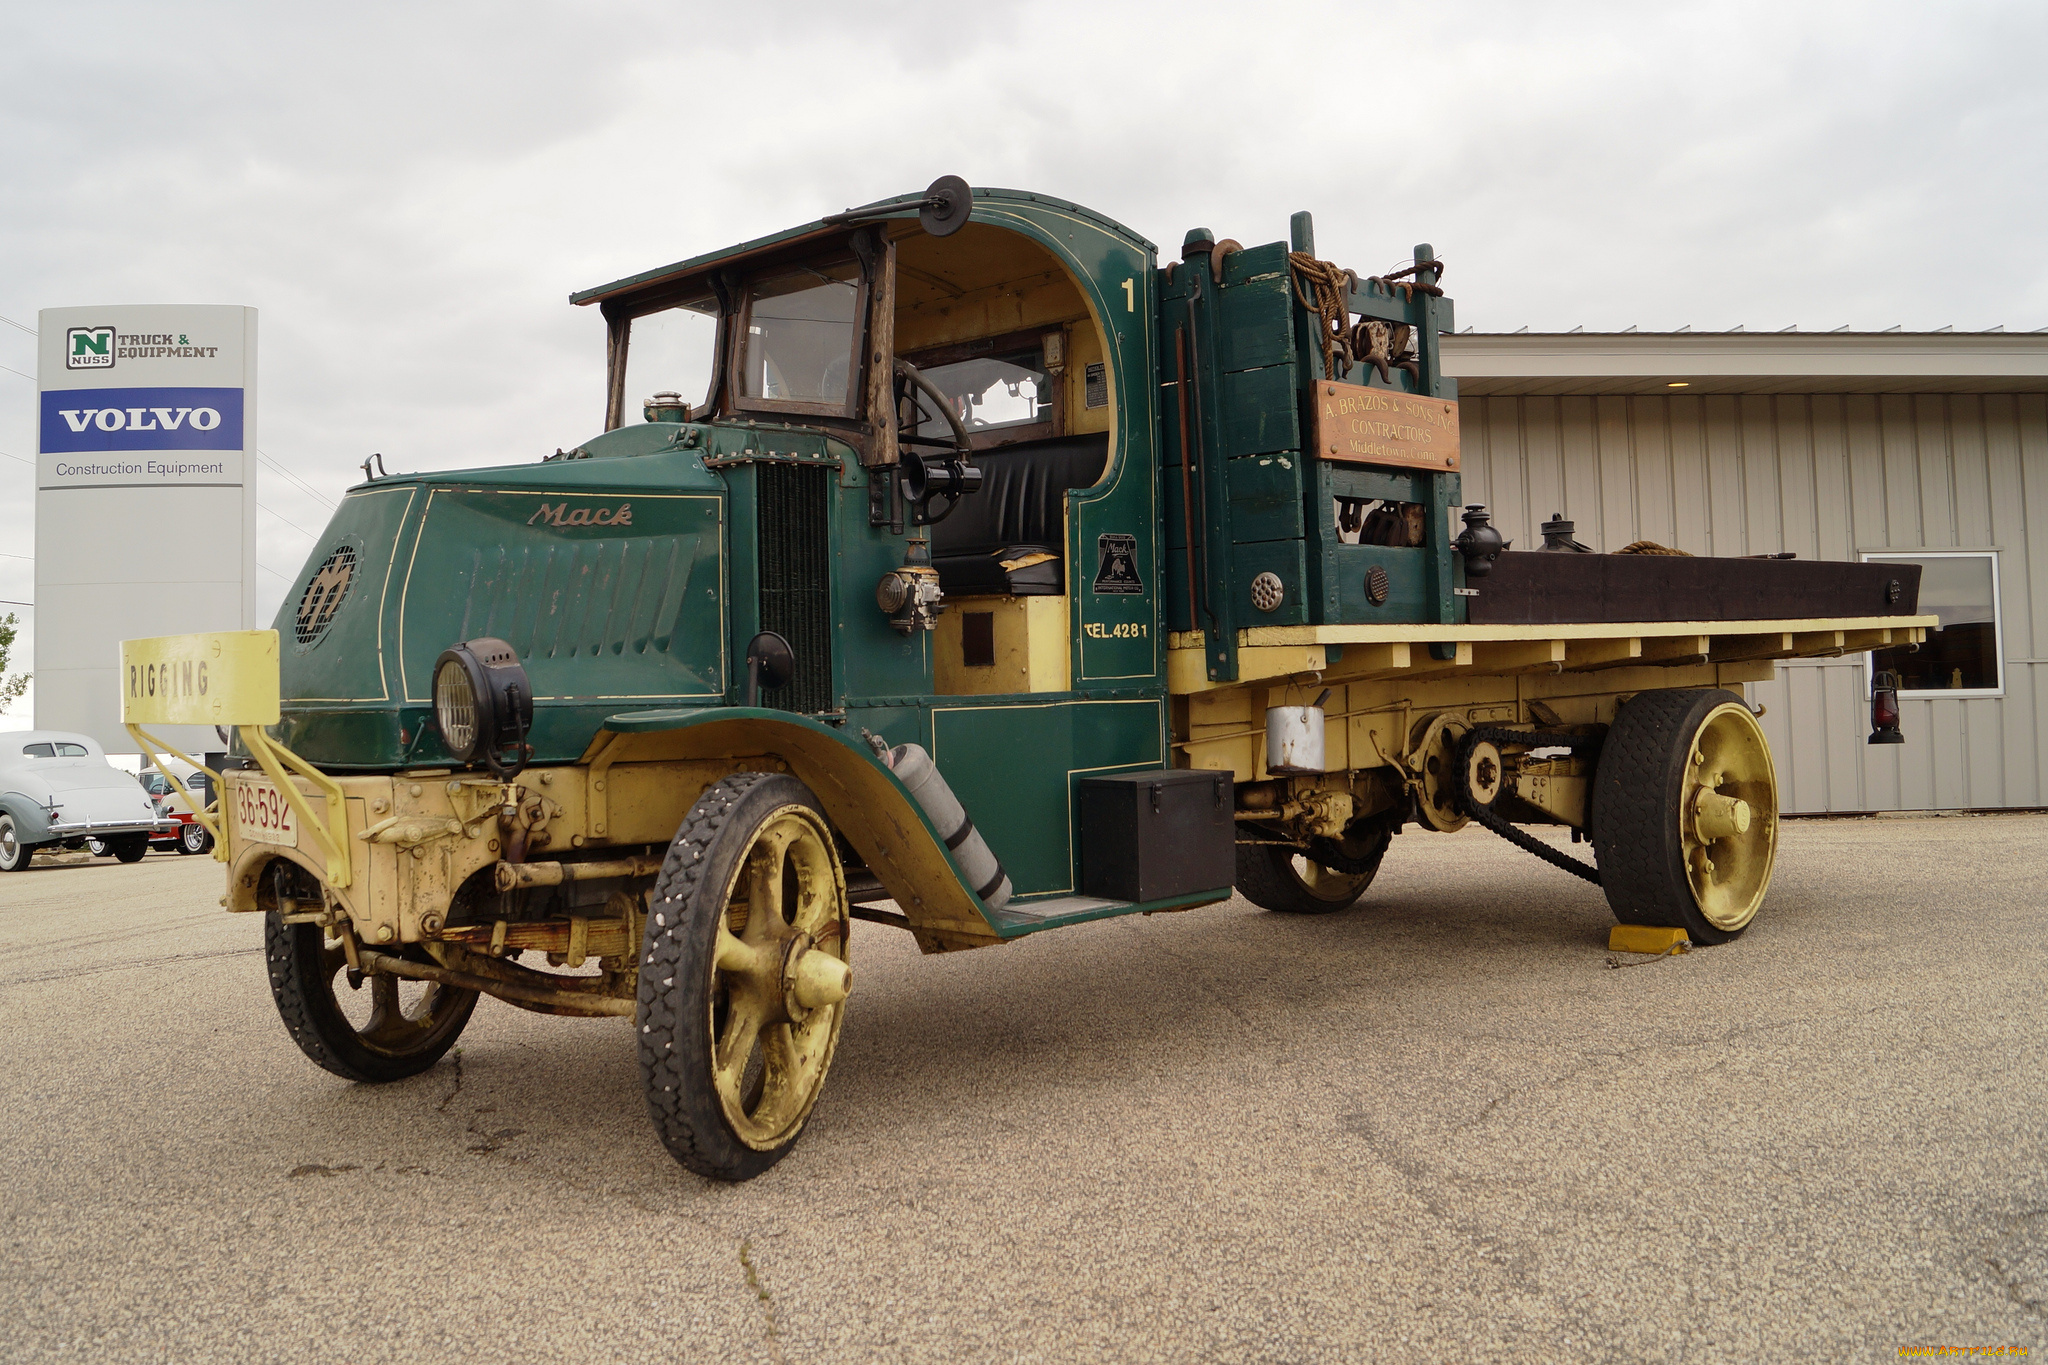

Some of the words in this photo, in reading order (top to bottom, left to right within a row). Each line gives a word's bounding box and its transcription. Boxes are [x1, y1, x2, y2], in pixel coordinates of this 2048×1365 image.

[1121, 277, 1134, 313] 1
[118, 335, 174, 345] TRUCK
[178, 334, 190, 345] &
[71, 356, 110, 365] NUSS
[118, 347, 218, 359] EQUIPMENT
[58, 407, 222, 432] VOLVO
[1325, 403, 1338, 420] A.
[1339, 395, 1389, 415] BRAZOS
[1392, 399, 1400, 412] &
[1351, 418, 1432, 444] CONTRACTORS
[56, 461, 142, 476] Construction
[147, 461, 223, 476] Equipment
[527, 503, 633, 527] Mack
[1107, 543, 1128, 554] Mack
[131, 661, 208, 698] RIGGING
